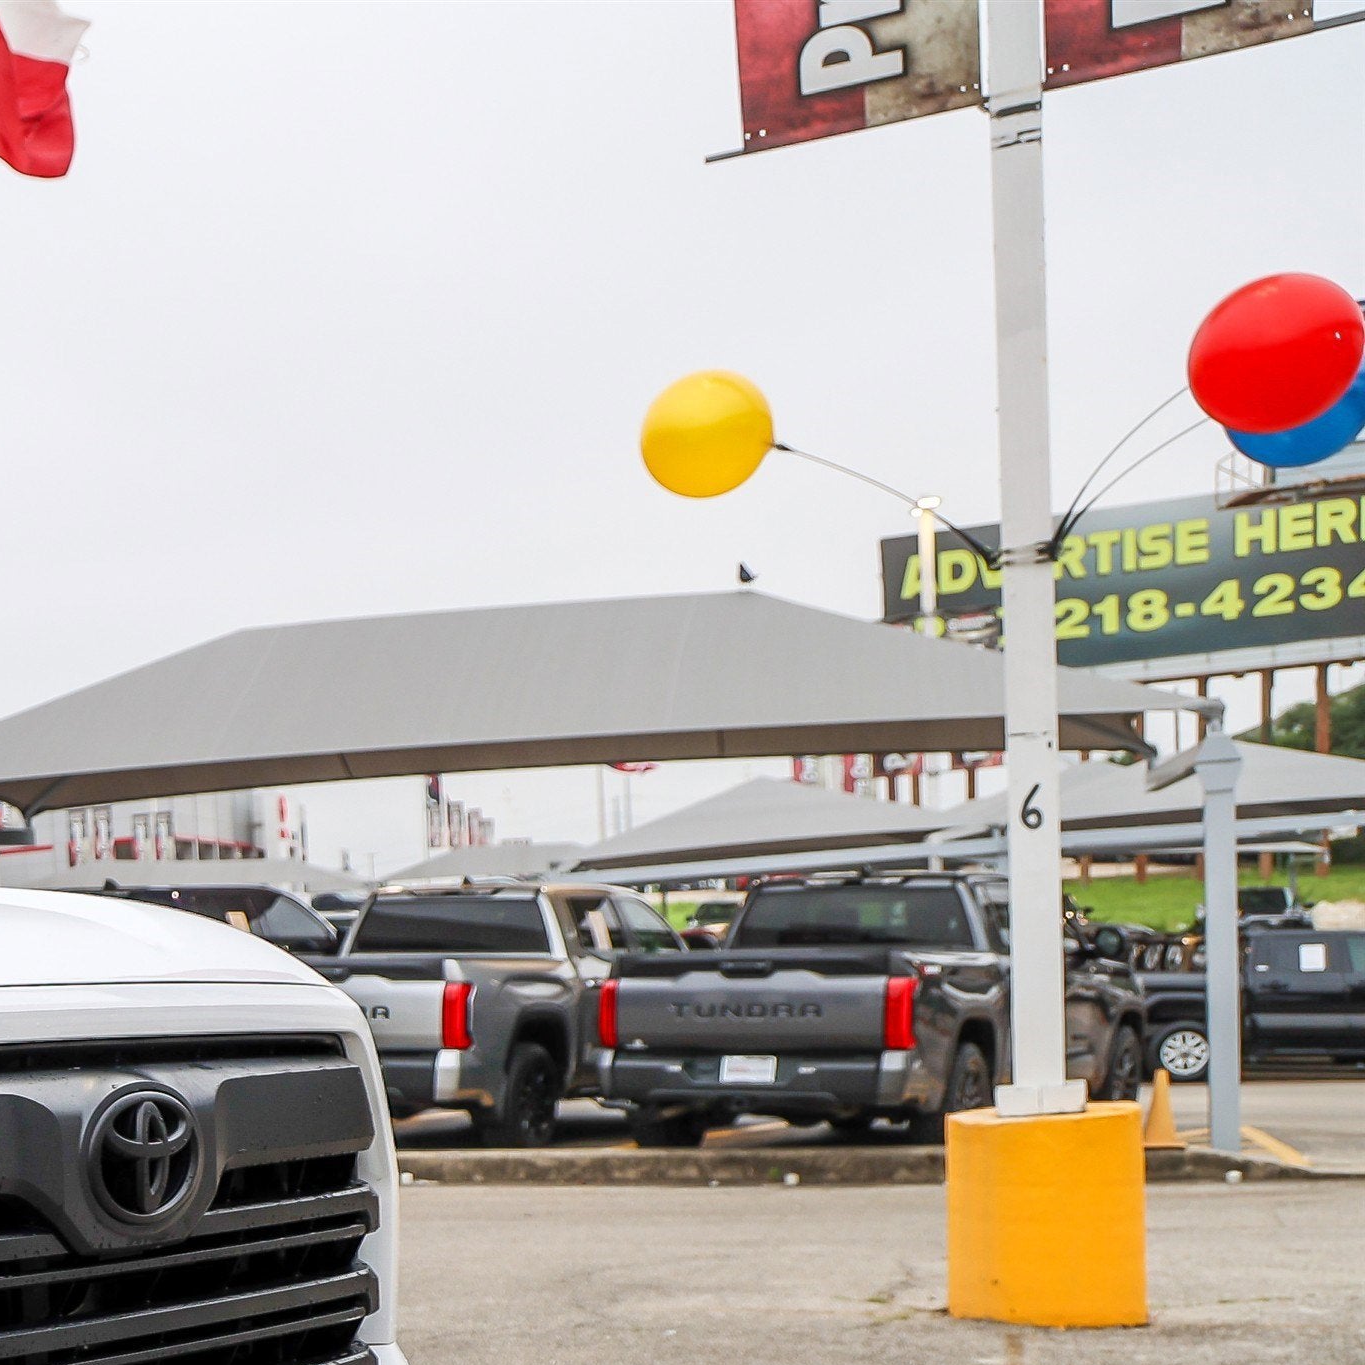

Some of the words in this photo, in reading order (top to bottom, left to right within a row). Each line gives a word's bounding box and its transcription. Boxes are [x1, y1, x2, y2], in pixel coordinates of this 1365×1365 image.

[800, 0, 905, 96] P
[900, 518, 1210, 599] ADVRTISE
[1233, 497, 1365, 558] HER
[1021, 783, 1042, 830] 6
[670, 1002, 823, 1019] TUNDRA
